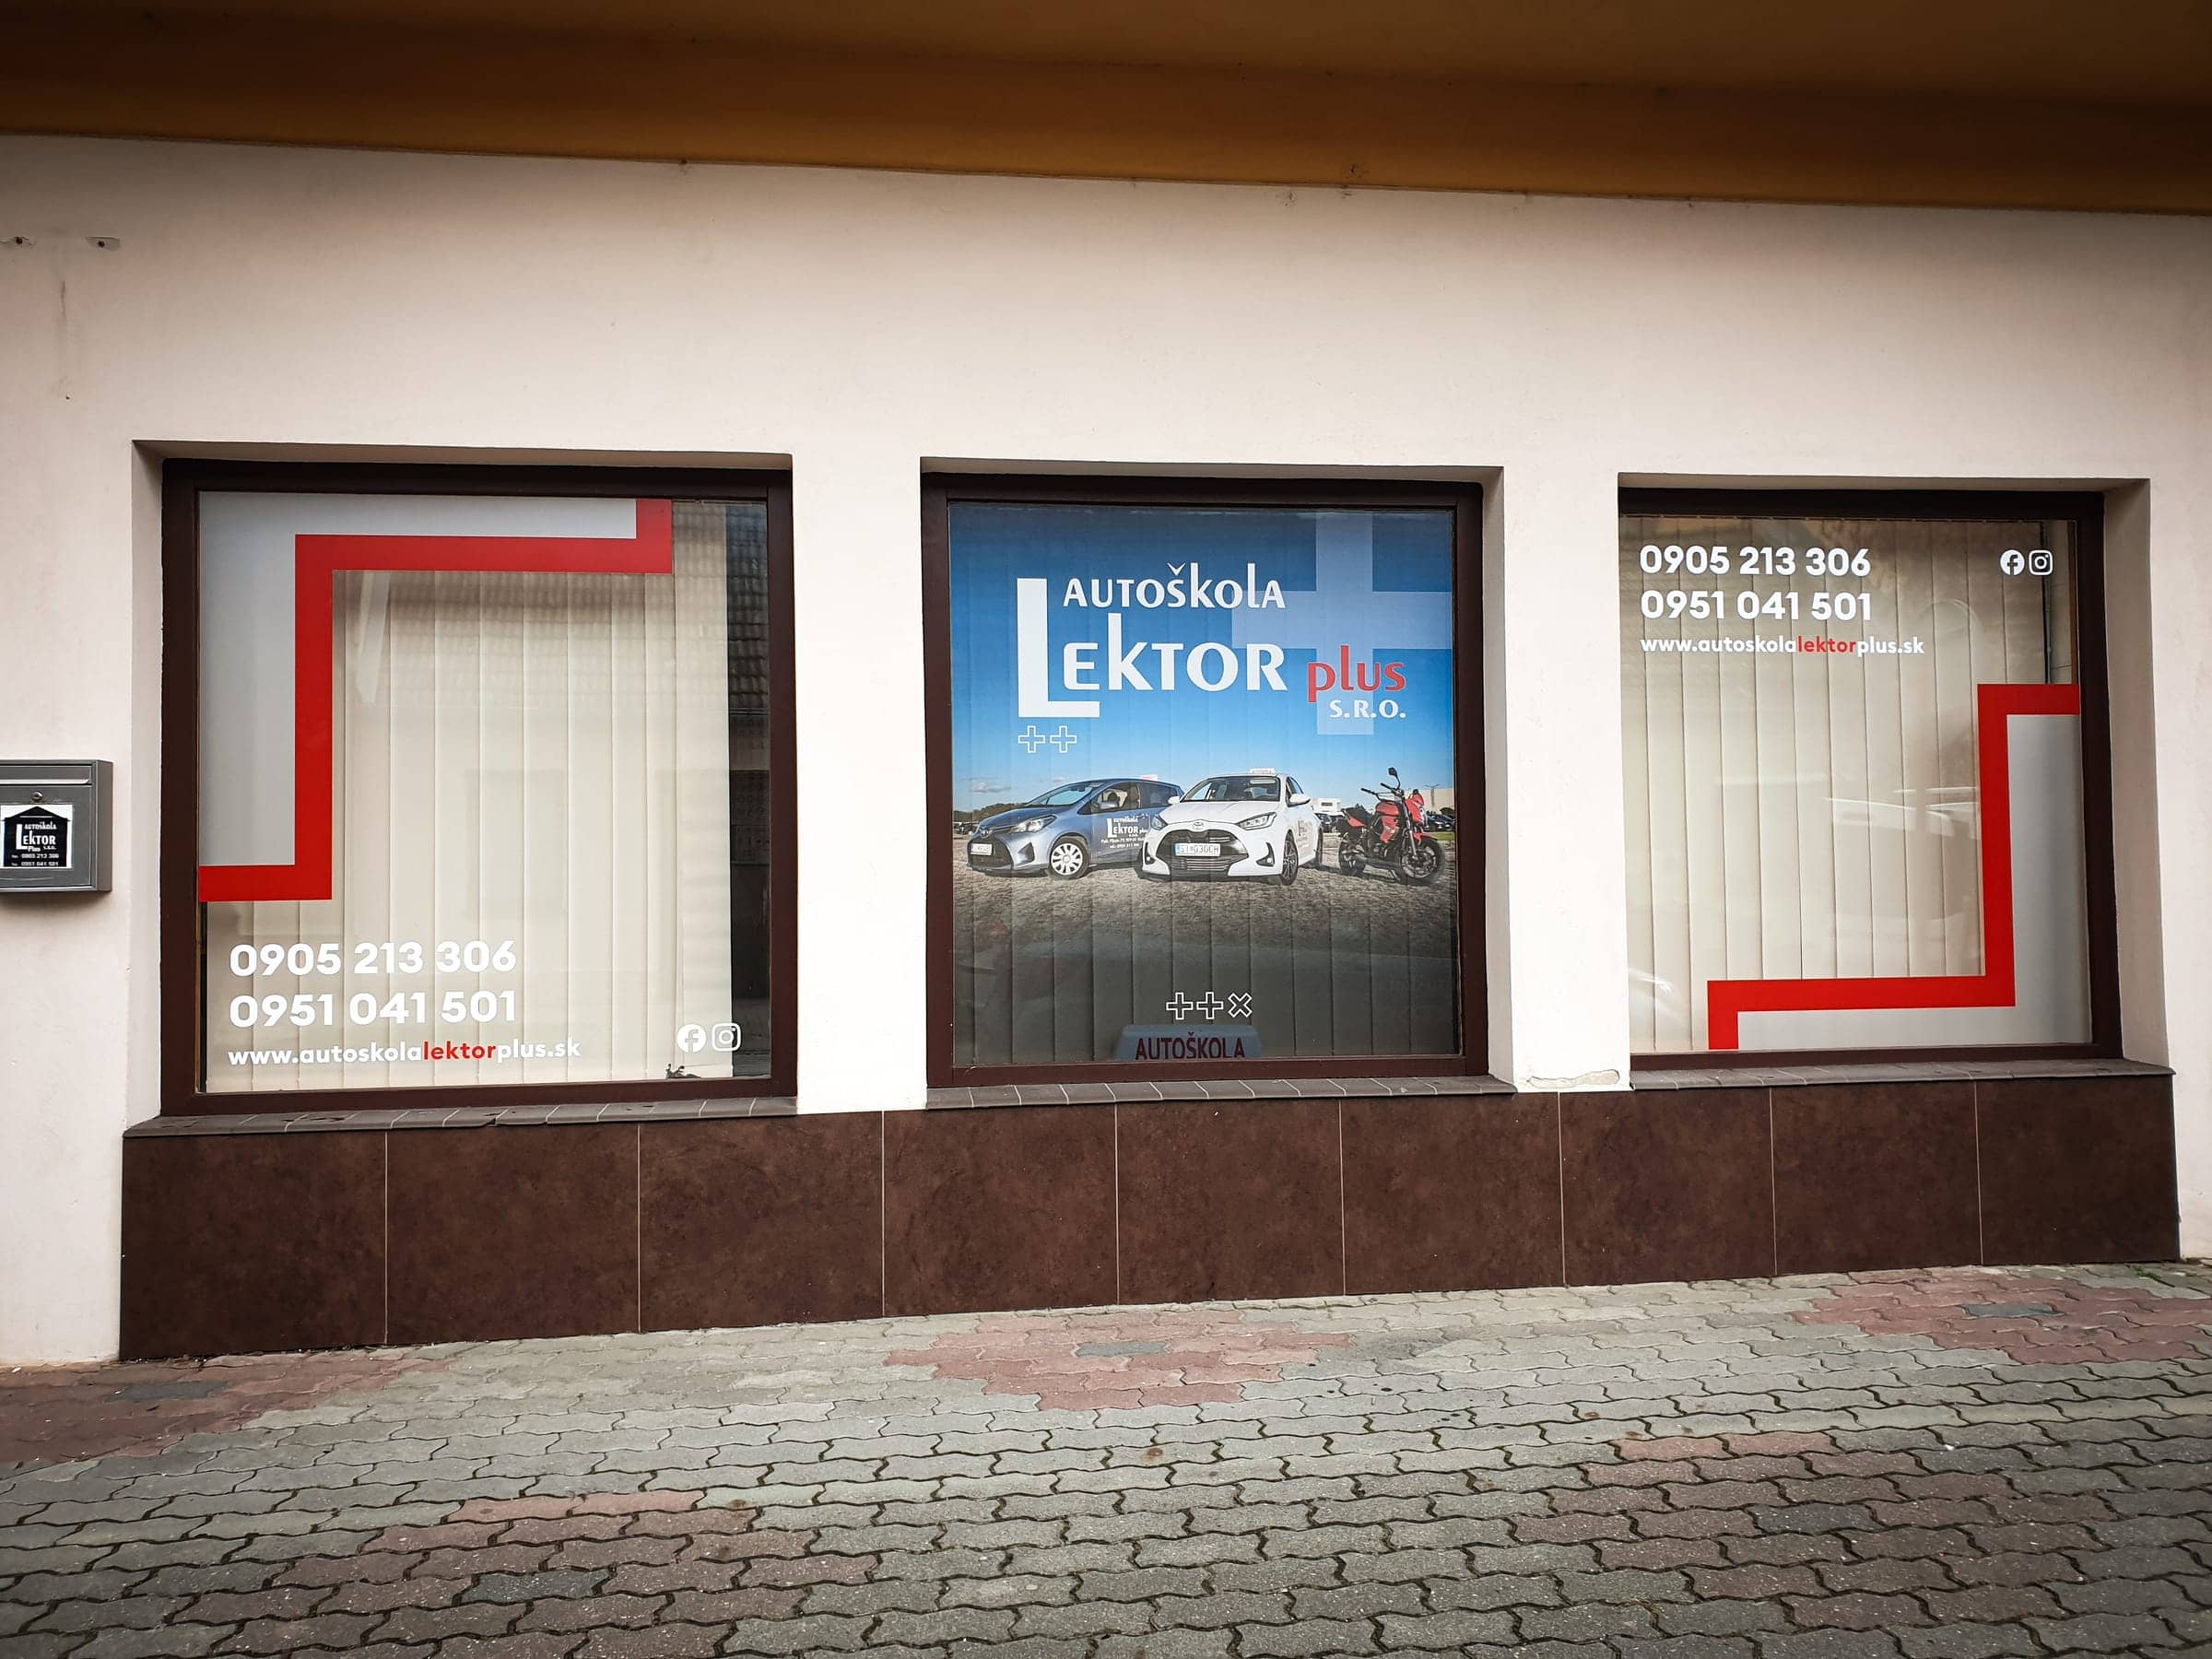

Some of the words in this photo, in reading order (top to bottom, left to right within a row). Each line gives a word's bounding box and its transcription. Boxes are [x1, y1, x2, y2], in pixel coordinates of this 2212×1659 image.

[1640, 545, 1730, 574] 0905
[1739, 546, 1796, 575] 213
[1806, 547, 1871, 577] 306
[1641, 590, 1724, 619] 0951
[1736, 591, 1799, 620] 041
[1811, 592, 1871, 621] 501
[1641, 635, 1925, 657] www.autoskolalektorplus.sk
[1308, 645, 1407, 703] plus
[229, 942, 342, 977] 0905
[353, 941, 424, 975] 213
[435, 940, 517, 973] 306
[229, 994, 334, 1028] 0951
[349, 992, 426, 1025] 041
[441, 990, 516, 1023] 501
[228, 1038, 582, 1065] www.autoskolalektorplus.sk
[1135, 1031, 1246, 1060] AUTOŠKOLA
